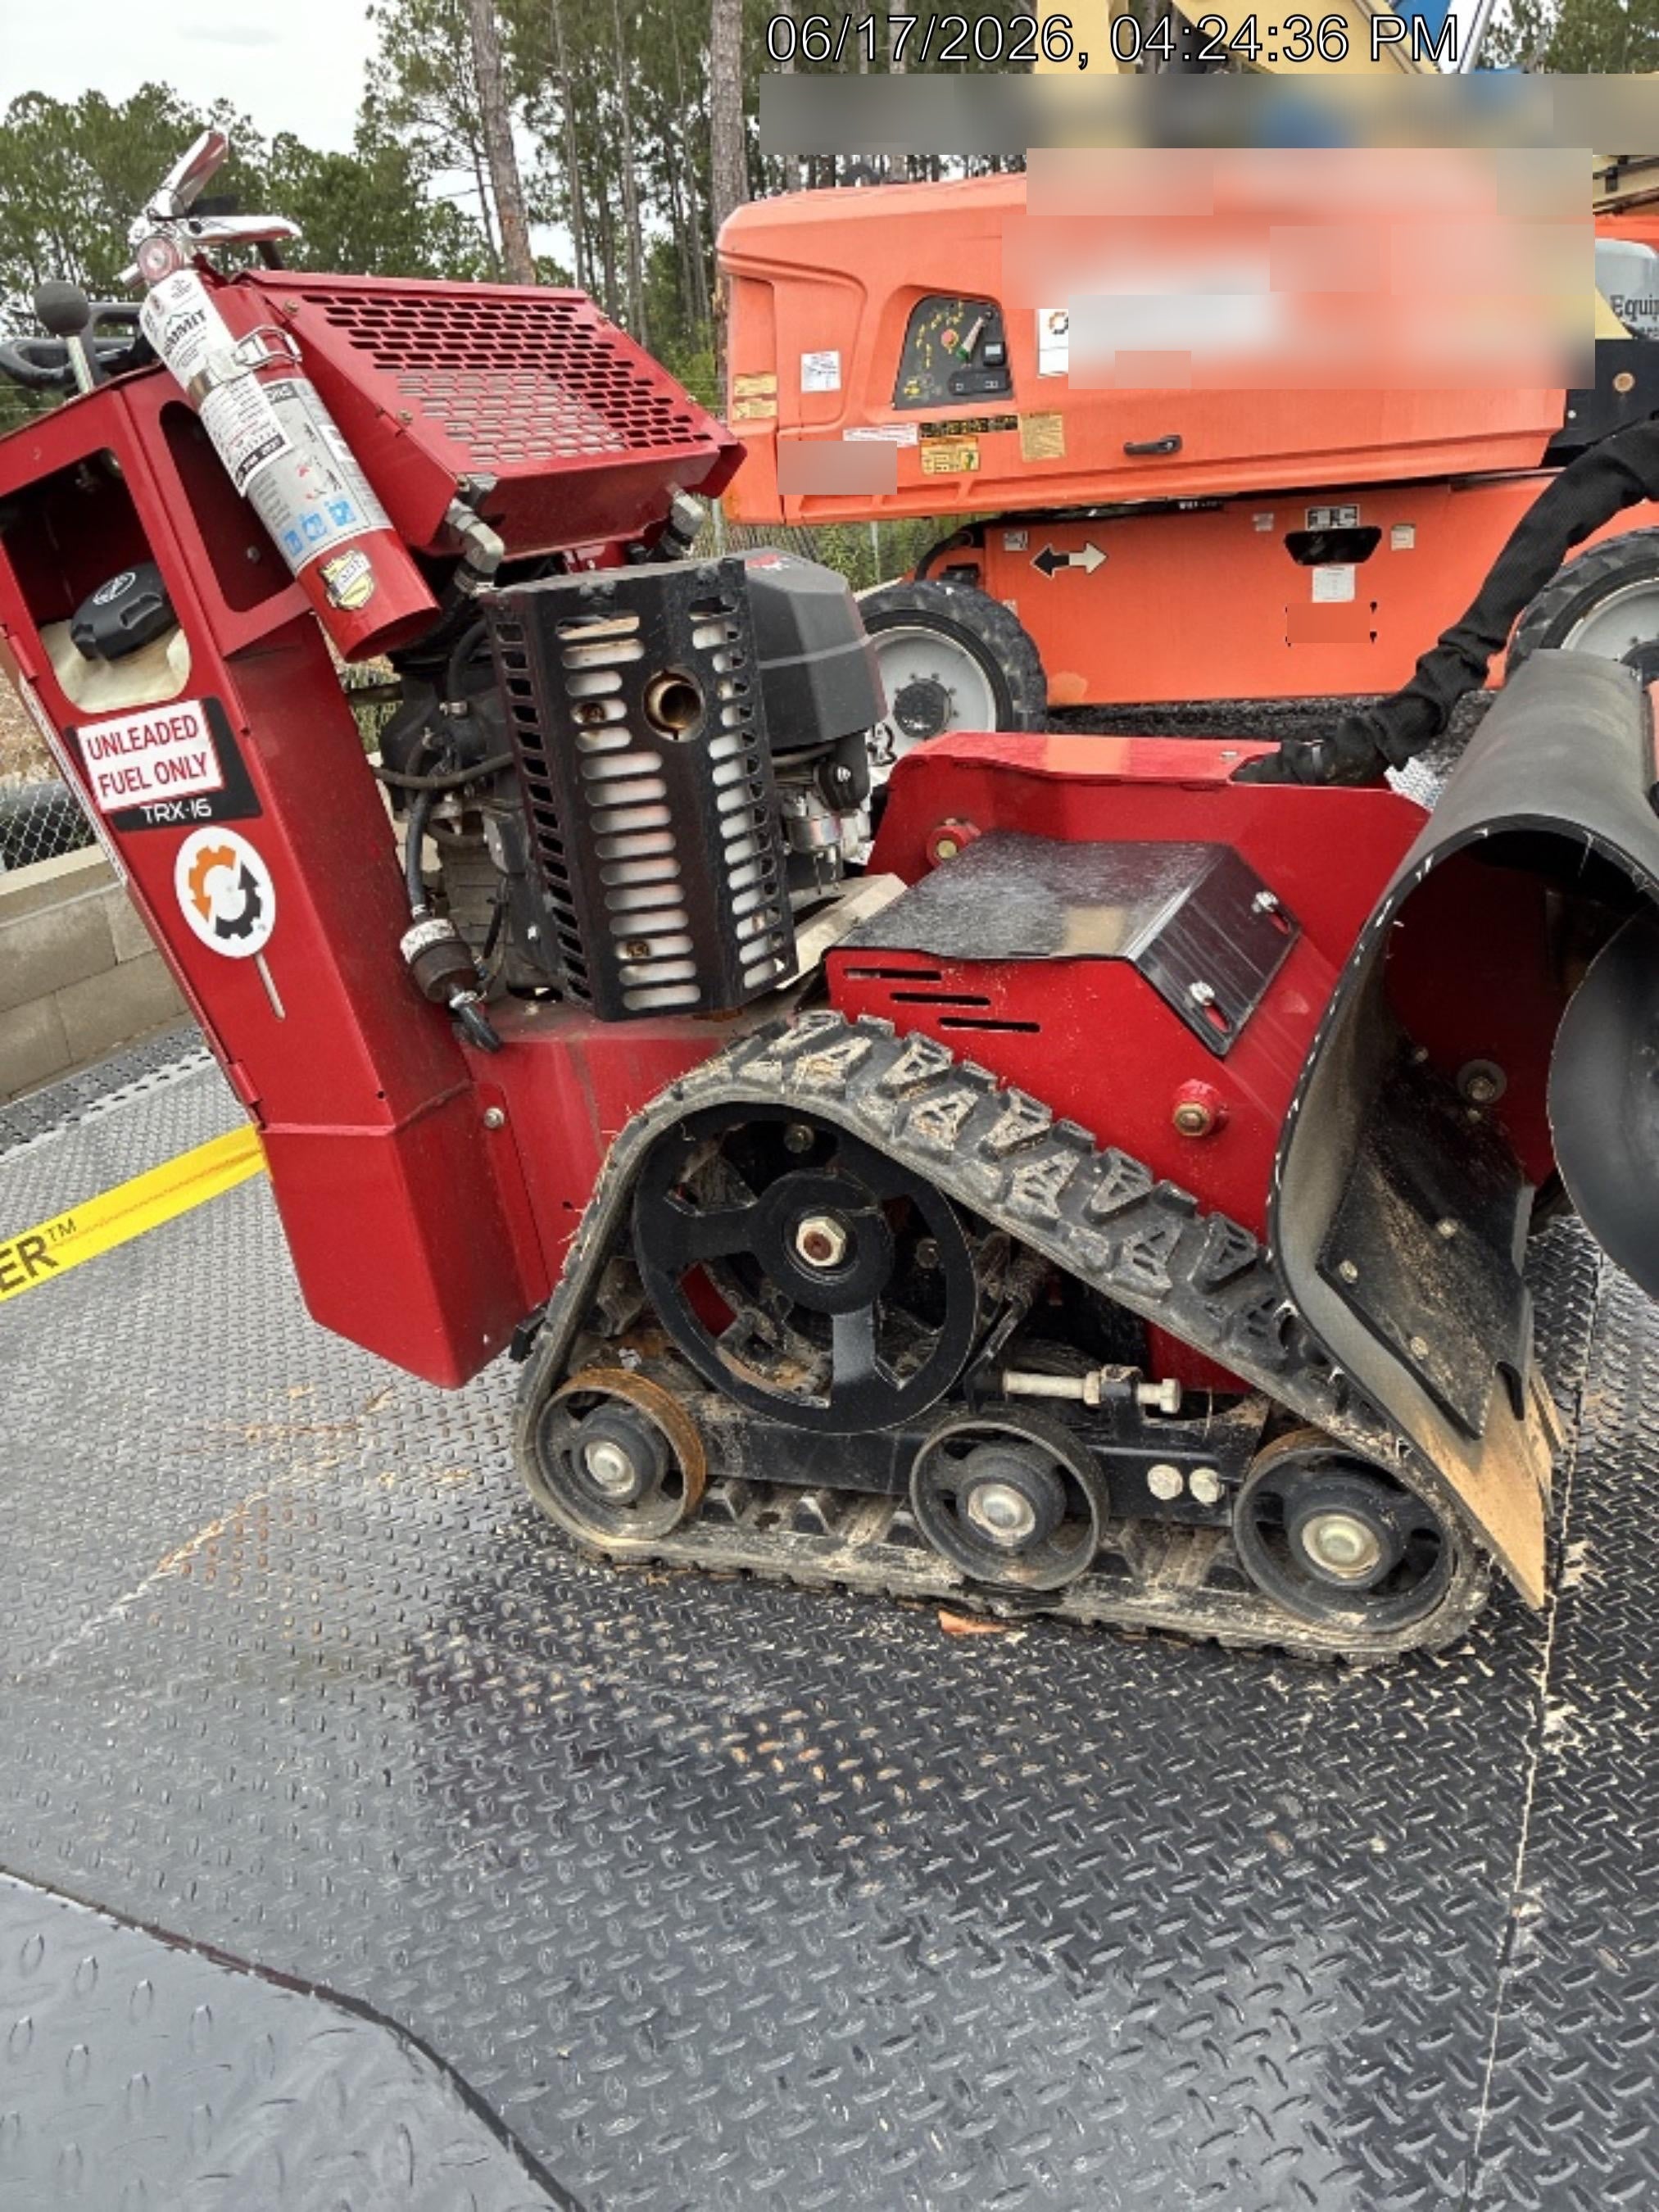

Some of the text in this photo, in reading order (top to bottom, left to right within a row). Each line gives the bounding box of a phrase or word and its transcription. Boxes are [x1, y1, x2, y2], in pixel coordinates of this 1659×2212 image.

[87, 714, 199, 760] UNLEADED
[97, 751, 208, 798] FUEL ONLY
[139, 797, 212, 823] TRX-16
